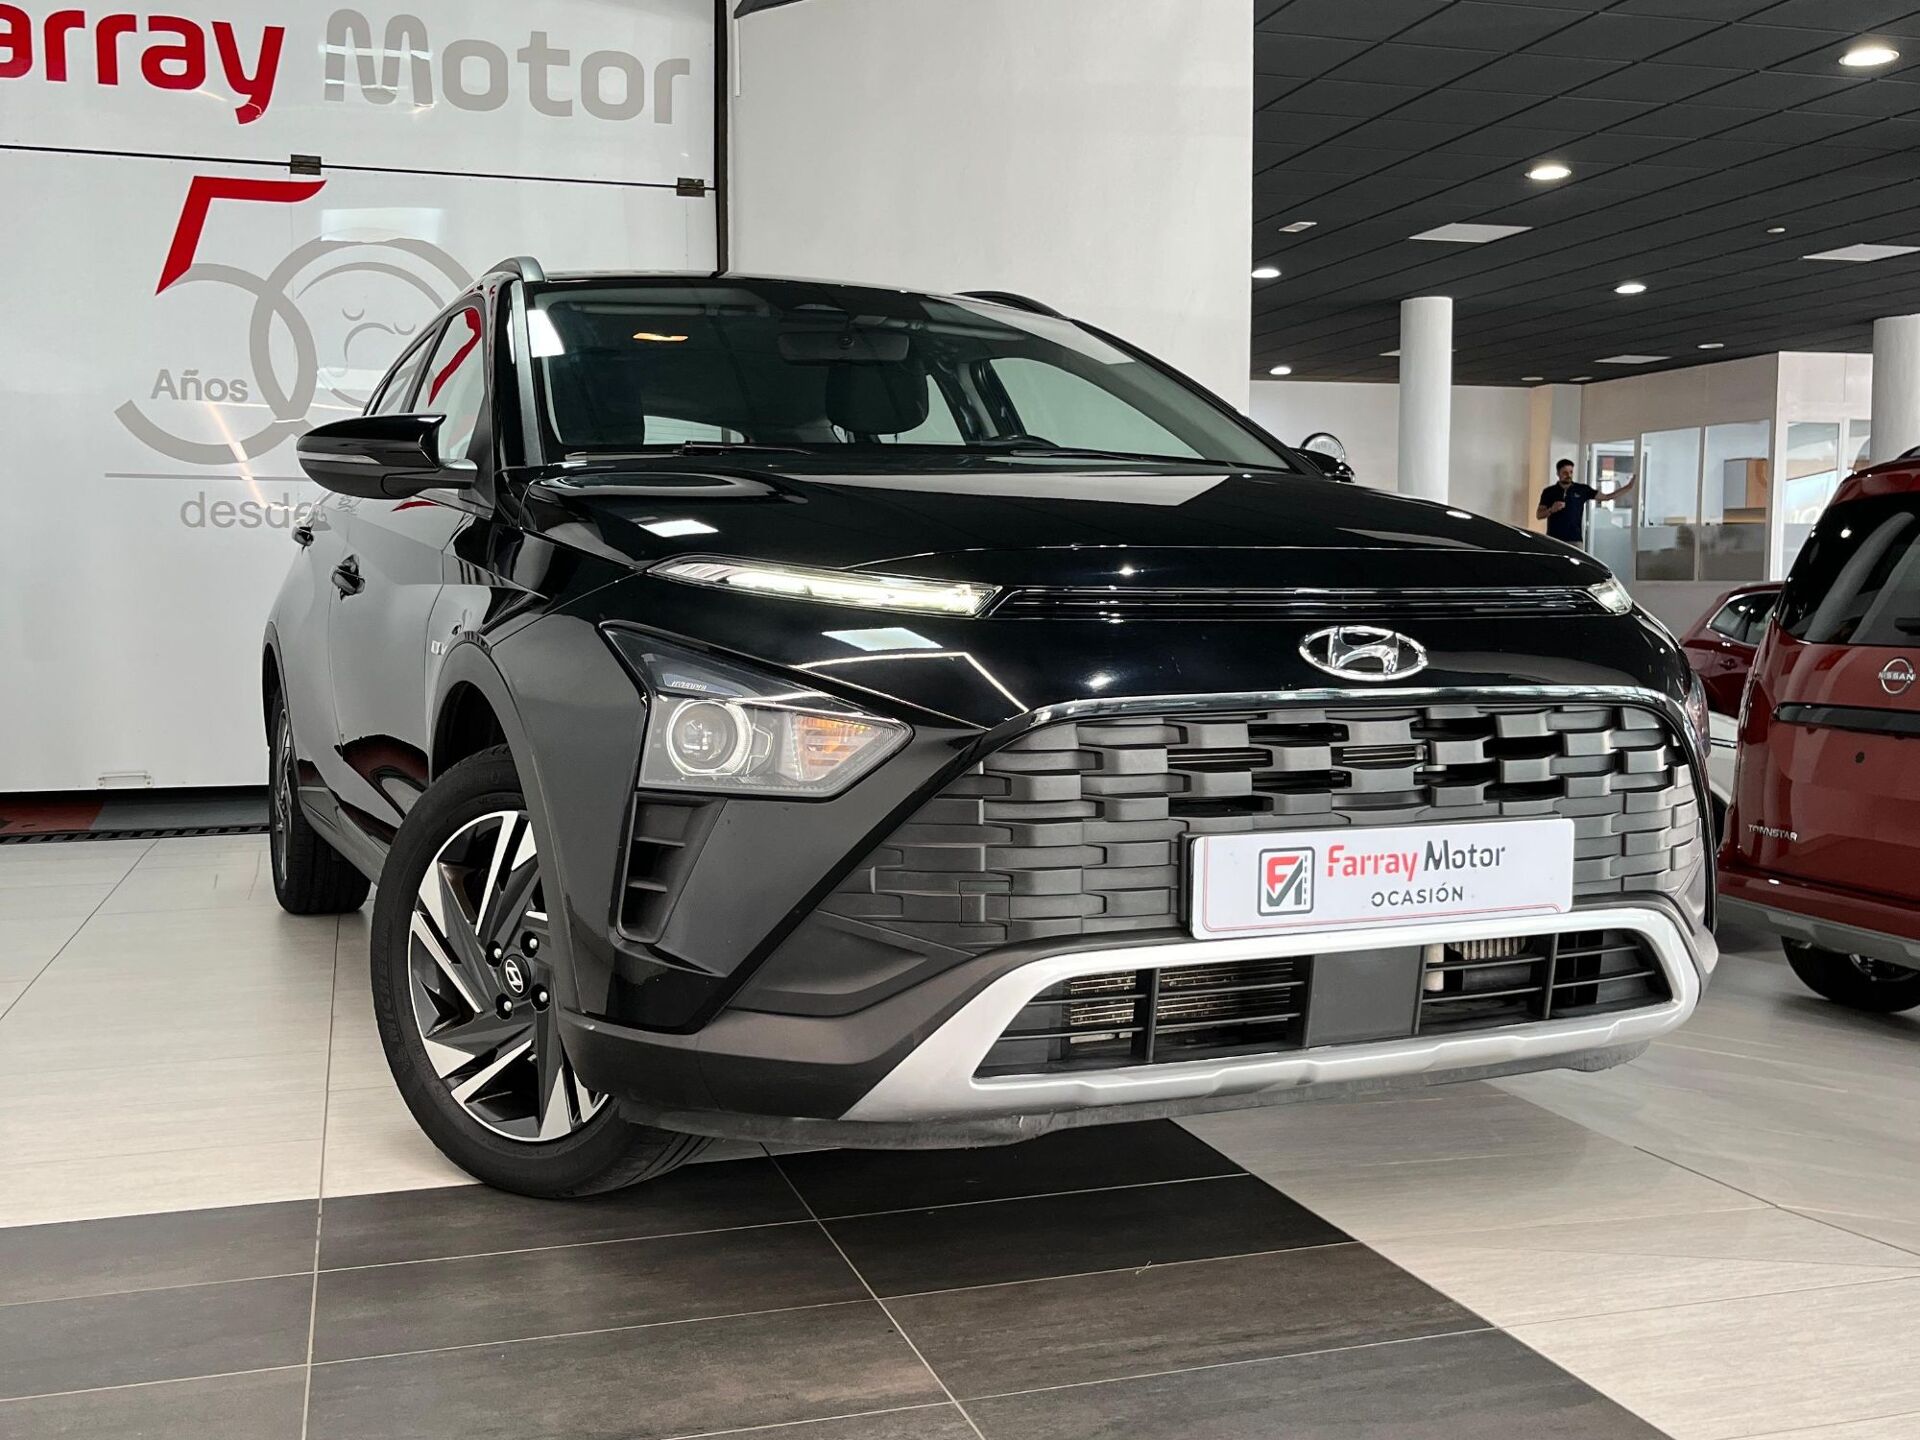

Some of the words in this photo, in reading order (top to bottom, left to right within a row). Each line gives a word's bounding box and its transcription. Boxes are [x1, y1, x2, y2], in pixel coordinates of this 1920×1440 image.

[324, 8, 691, 125] Motor
[150, 369, 249, 403] Años
[1878, 671, 1917, 682] NISSAN
[1326, 844, 1418, 881] Farray
[1423, 839, 1507, 872] Motor
[1371, 881, 1465, 907] OCASIÓN
